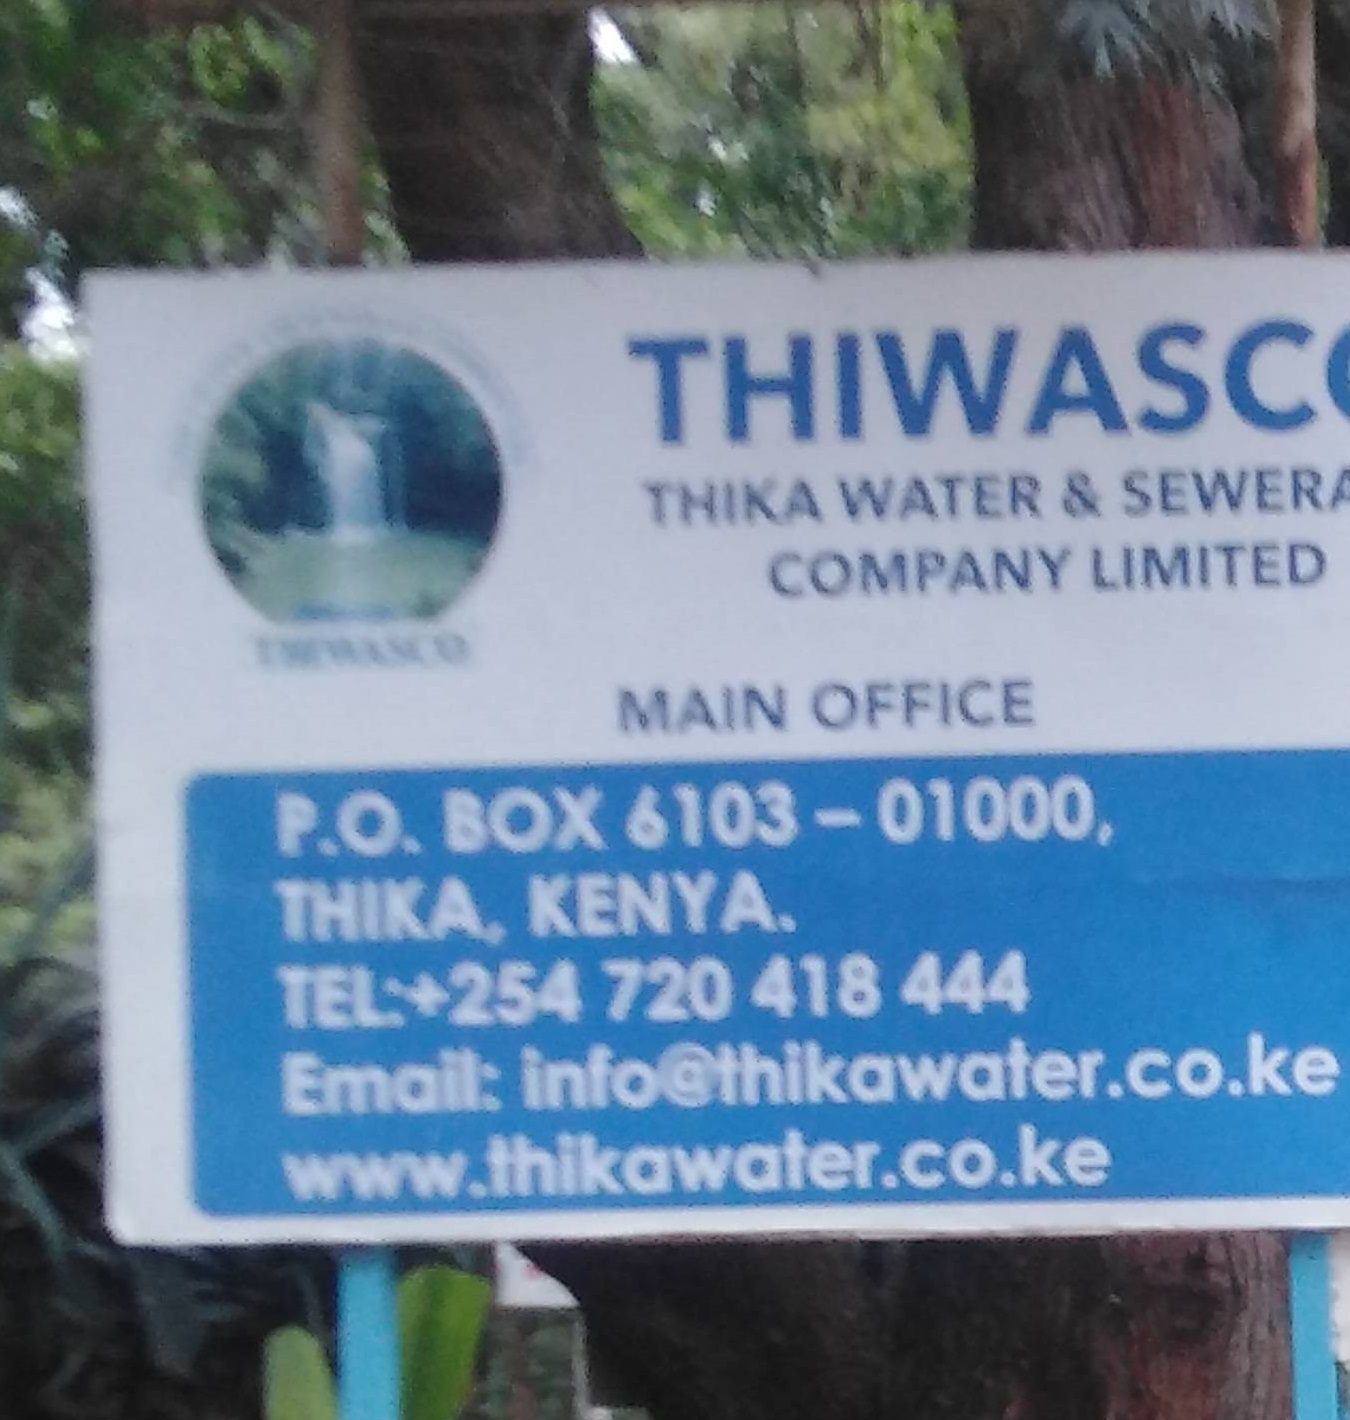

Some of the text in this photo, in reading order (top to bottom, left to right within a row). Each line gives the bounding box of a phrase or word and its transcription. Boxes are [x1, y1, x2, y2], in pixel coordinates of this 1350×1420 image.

[645, 478, 823, 524] THIKA
[837, 474, 1042, 521] WATER
[1061, 470, 1100, 519] &
[768, 540, 1327, 597] COMPANY LIMITED
[618, 679, 1034, 732] MAIN OFFICE
[274, 788, 422, 859] P.O.
[442, 785, 607, 855] BOX
[624, 779, 801, 851] 6103
[272, 869, 797, 946] THIKA, KENYA.
[600, 954, 735, 1024] 720
[749, 951, 883, 1020] 418
[898, 948, 1033, 1016] 444
[279, 1029, 1343, 1118] Email: info@thikawater.co.ke
[279, 1122, 1115, 1202] www.thikawater.co.ke
